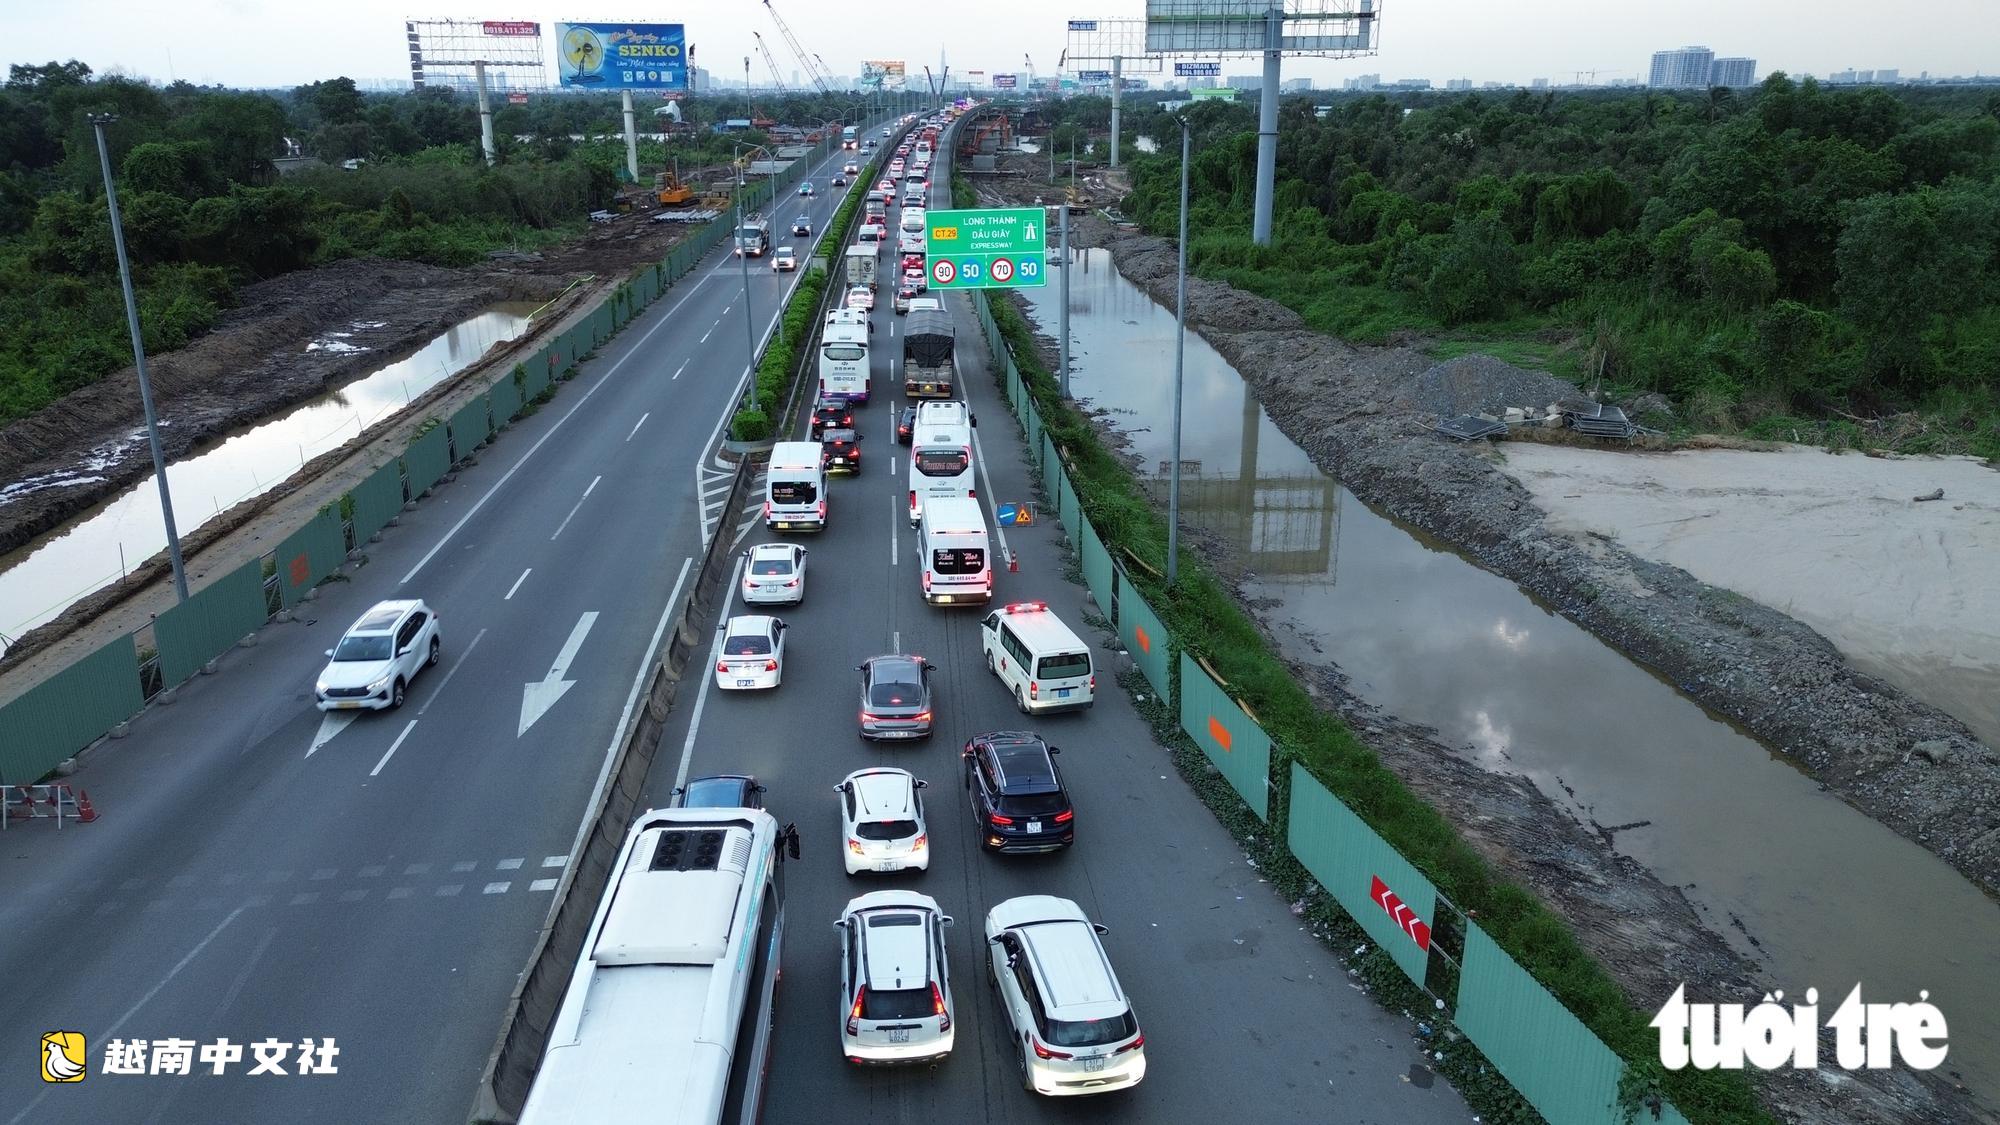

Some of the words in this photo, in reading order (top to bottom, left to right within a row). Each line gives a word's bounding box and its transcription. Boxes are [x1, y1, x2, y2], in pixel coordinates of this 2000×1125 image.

[485, 26, 534, 35] 0919.411.325
[618, 44, 680, 57] SENKO
[963, 217, 986, 226] LONG
[935, 228, 957, 238] CT.29
[970, 242, 1013, 250] EXPRESSWAY
[938, 266, 951, 278] 90
[962, 264, 979, 279] 50
[996, 264, 1009, 276] 70
[1020, 262, 1038, 277] 50
